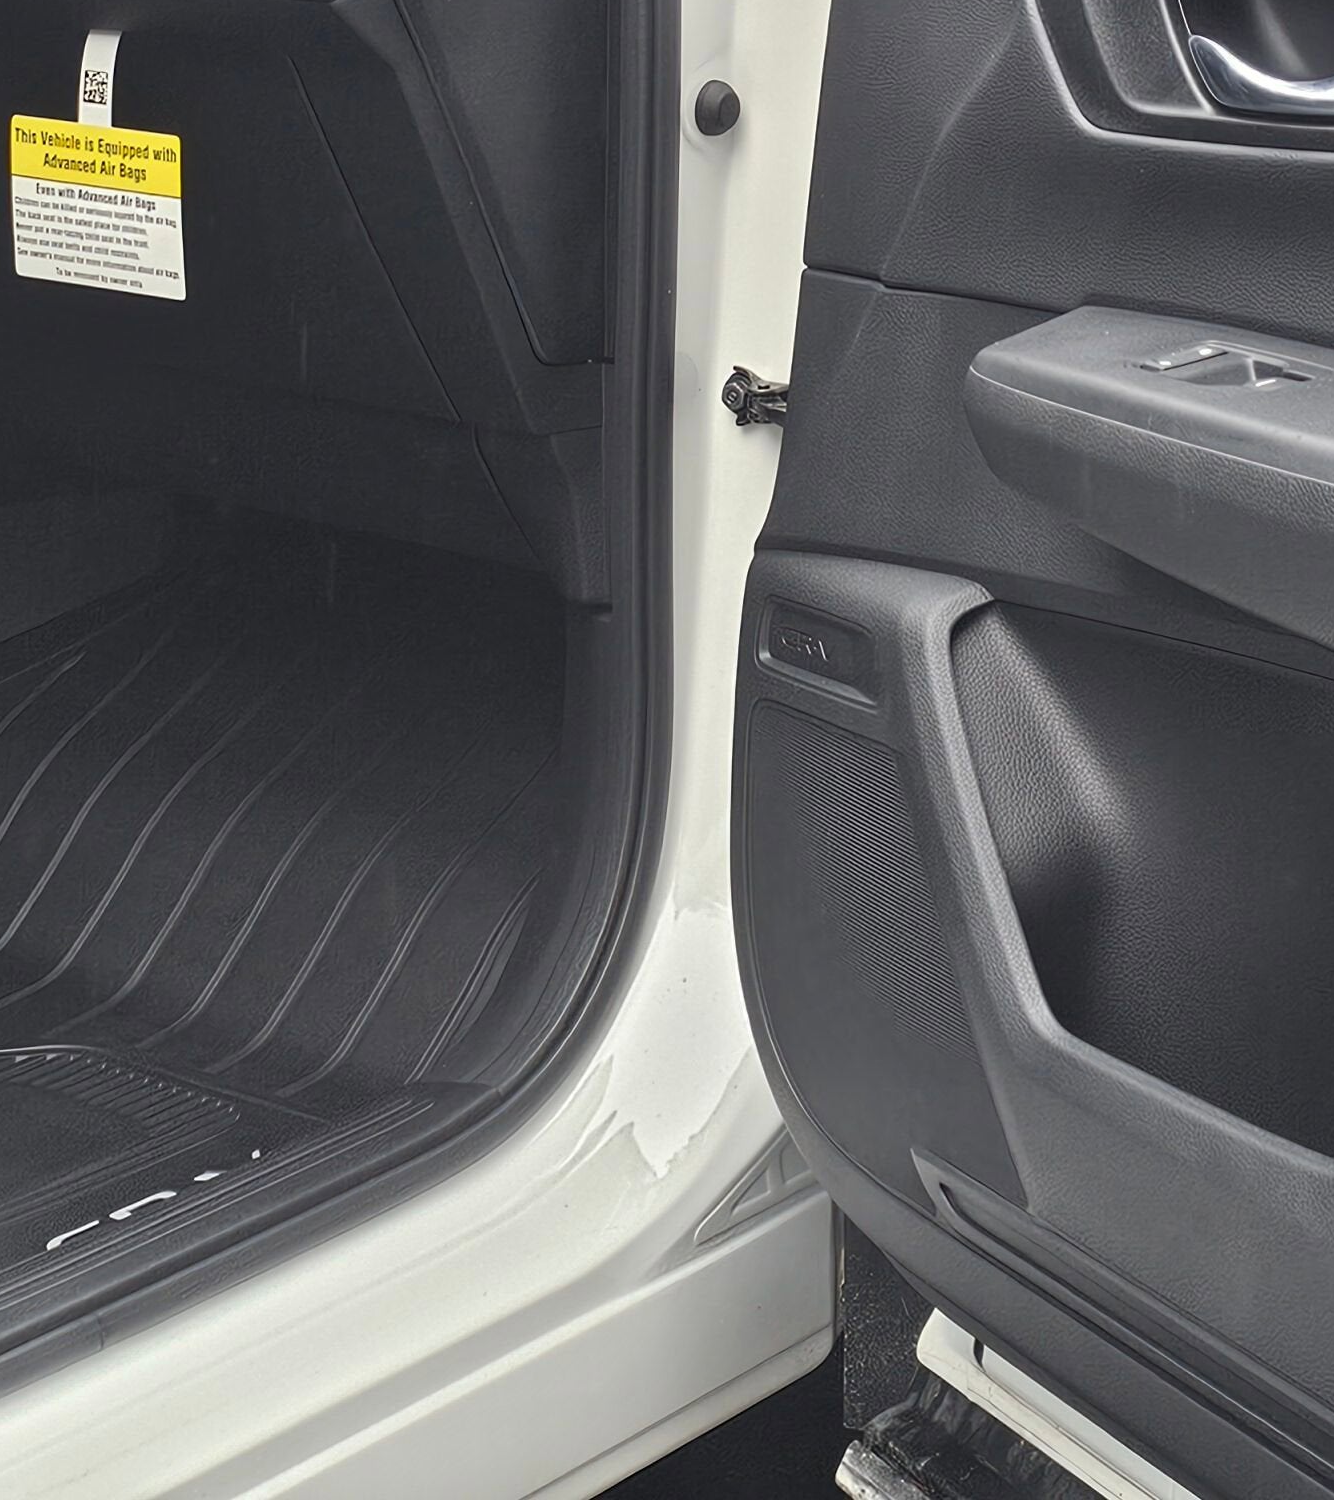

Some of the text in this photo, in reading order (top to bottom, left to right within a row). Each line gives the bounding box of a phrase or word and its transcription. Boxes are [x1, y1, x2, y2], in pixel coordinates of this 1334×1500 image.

[15, 127, 177, 163] This Vehicle is Equipped with
[43, 152, 147, 183] Advanced Air Bags
[36, 182, 156, 212] Even with Advanced Air Bags
